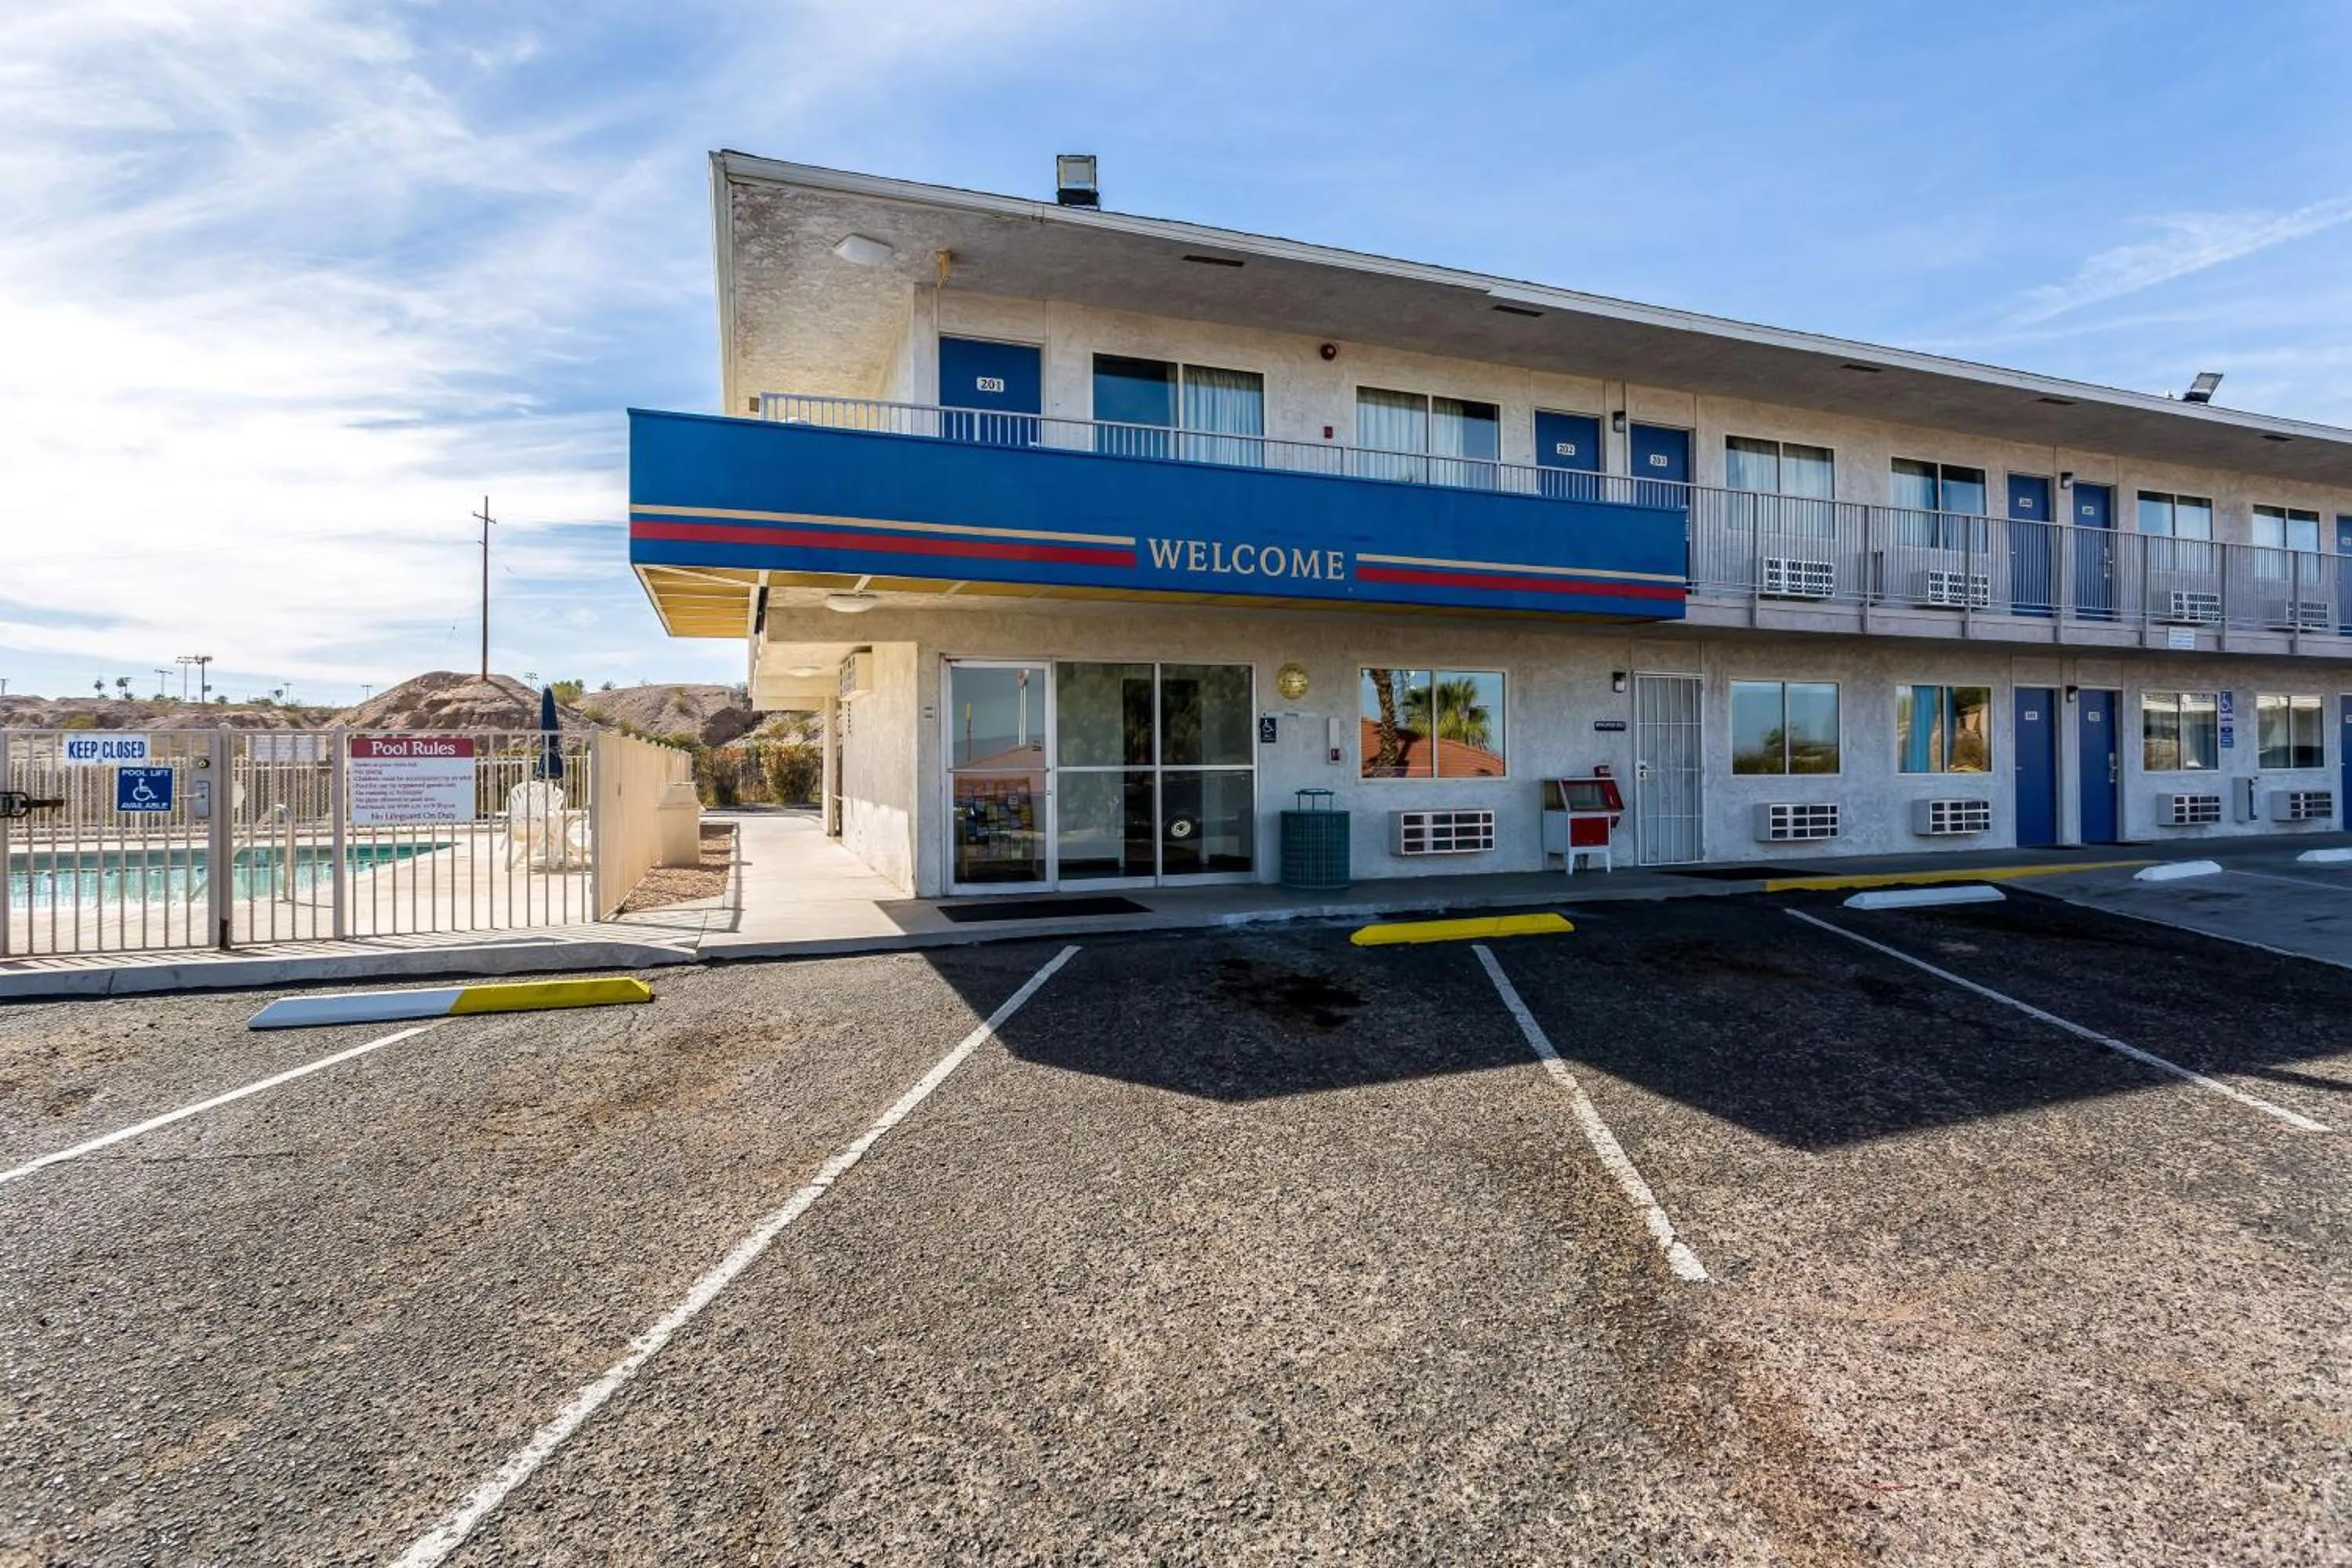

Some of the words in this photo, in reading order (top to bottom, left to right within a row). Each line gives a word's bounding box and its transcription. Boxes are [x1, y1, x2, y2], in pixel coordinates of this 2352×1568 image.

[981, 379, 1001, 390] 201
[1147, 538, 1345, 580] WELCOME
[68, 740, 98, 759] KEEP
[103, 740, 145, 759] CLOSED
[372, 741, 408, 756] Pool
[412, 741, 456, 756] Rules
